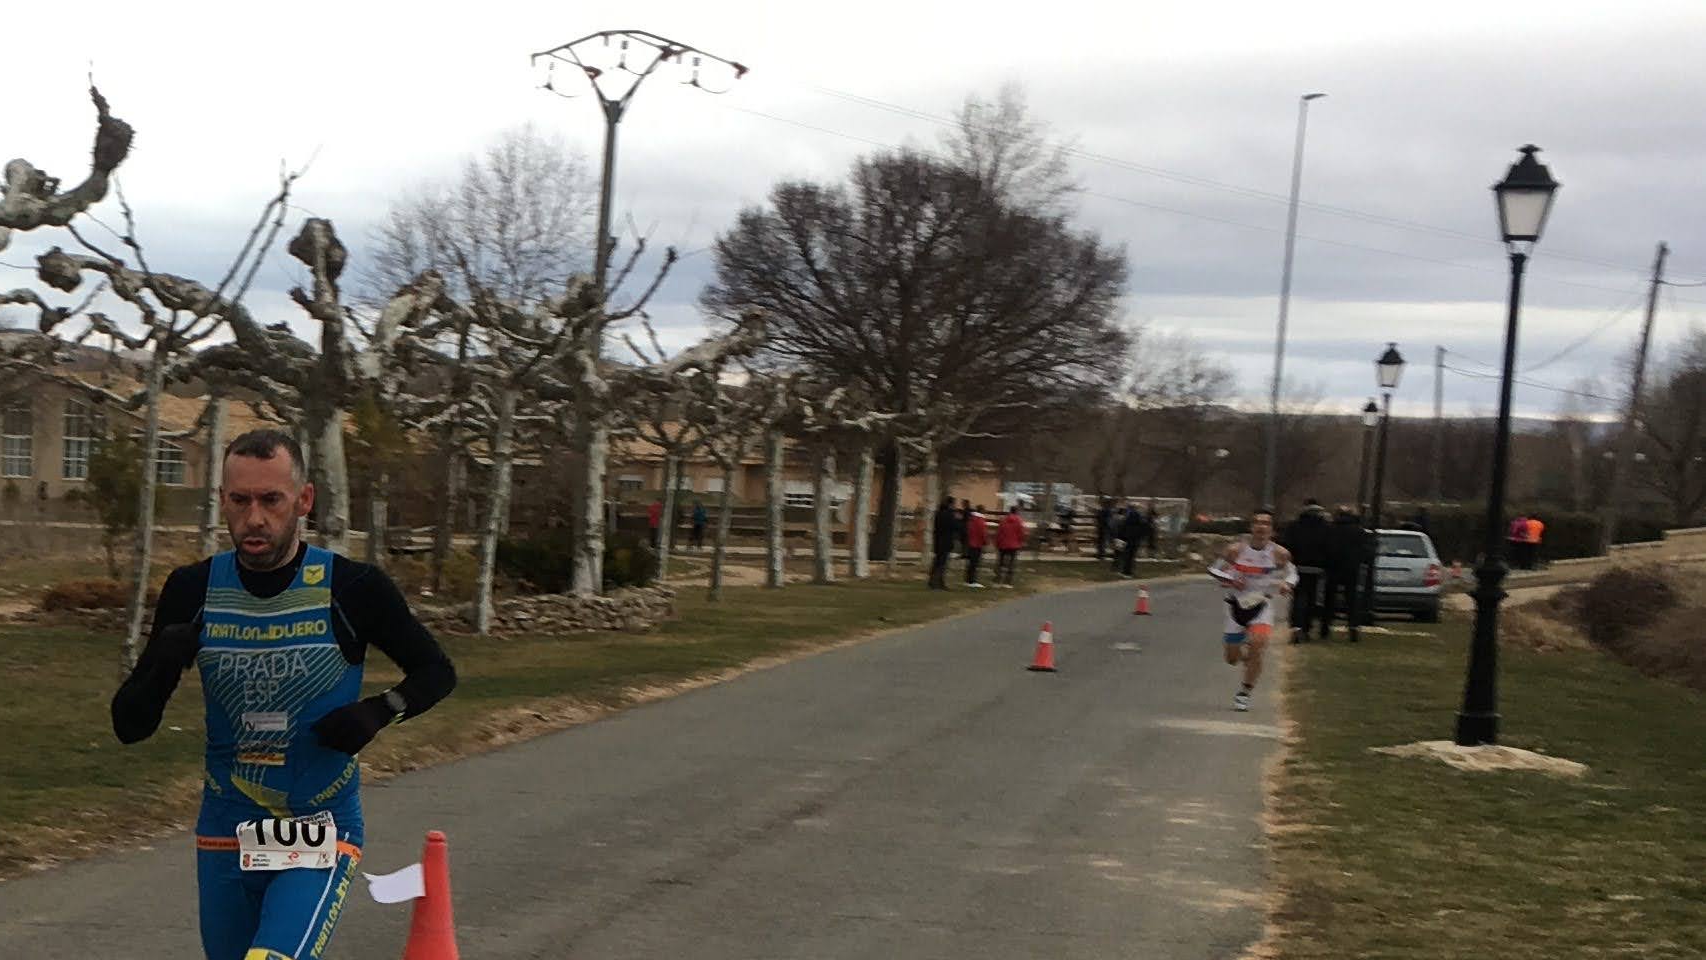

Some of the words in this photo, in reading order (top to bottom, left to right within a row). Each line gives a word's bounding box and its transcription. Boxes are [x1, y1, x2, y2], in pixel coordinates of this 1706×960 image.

[216, 651, 309, 680] PRADA
[244, 680, 280, 704] ESP
[246, 818, 326, 847] 100
